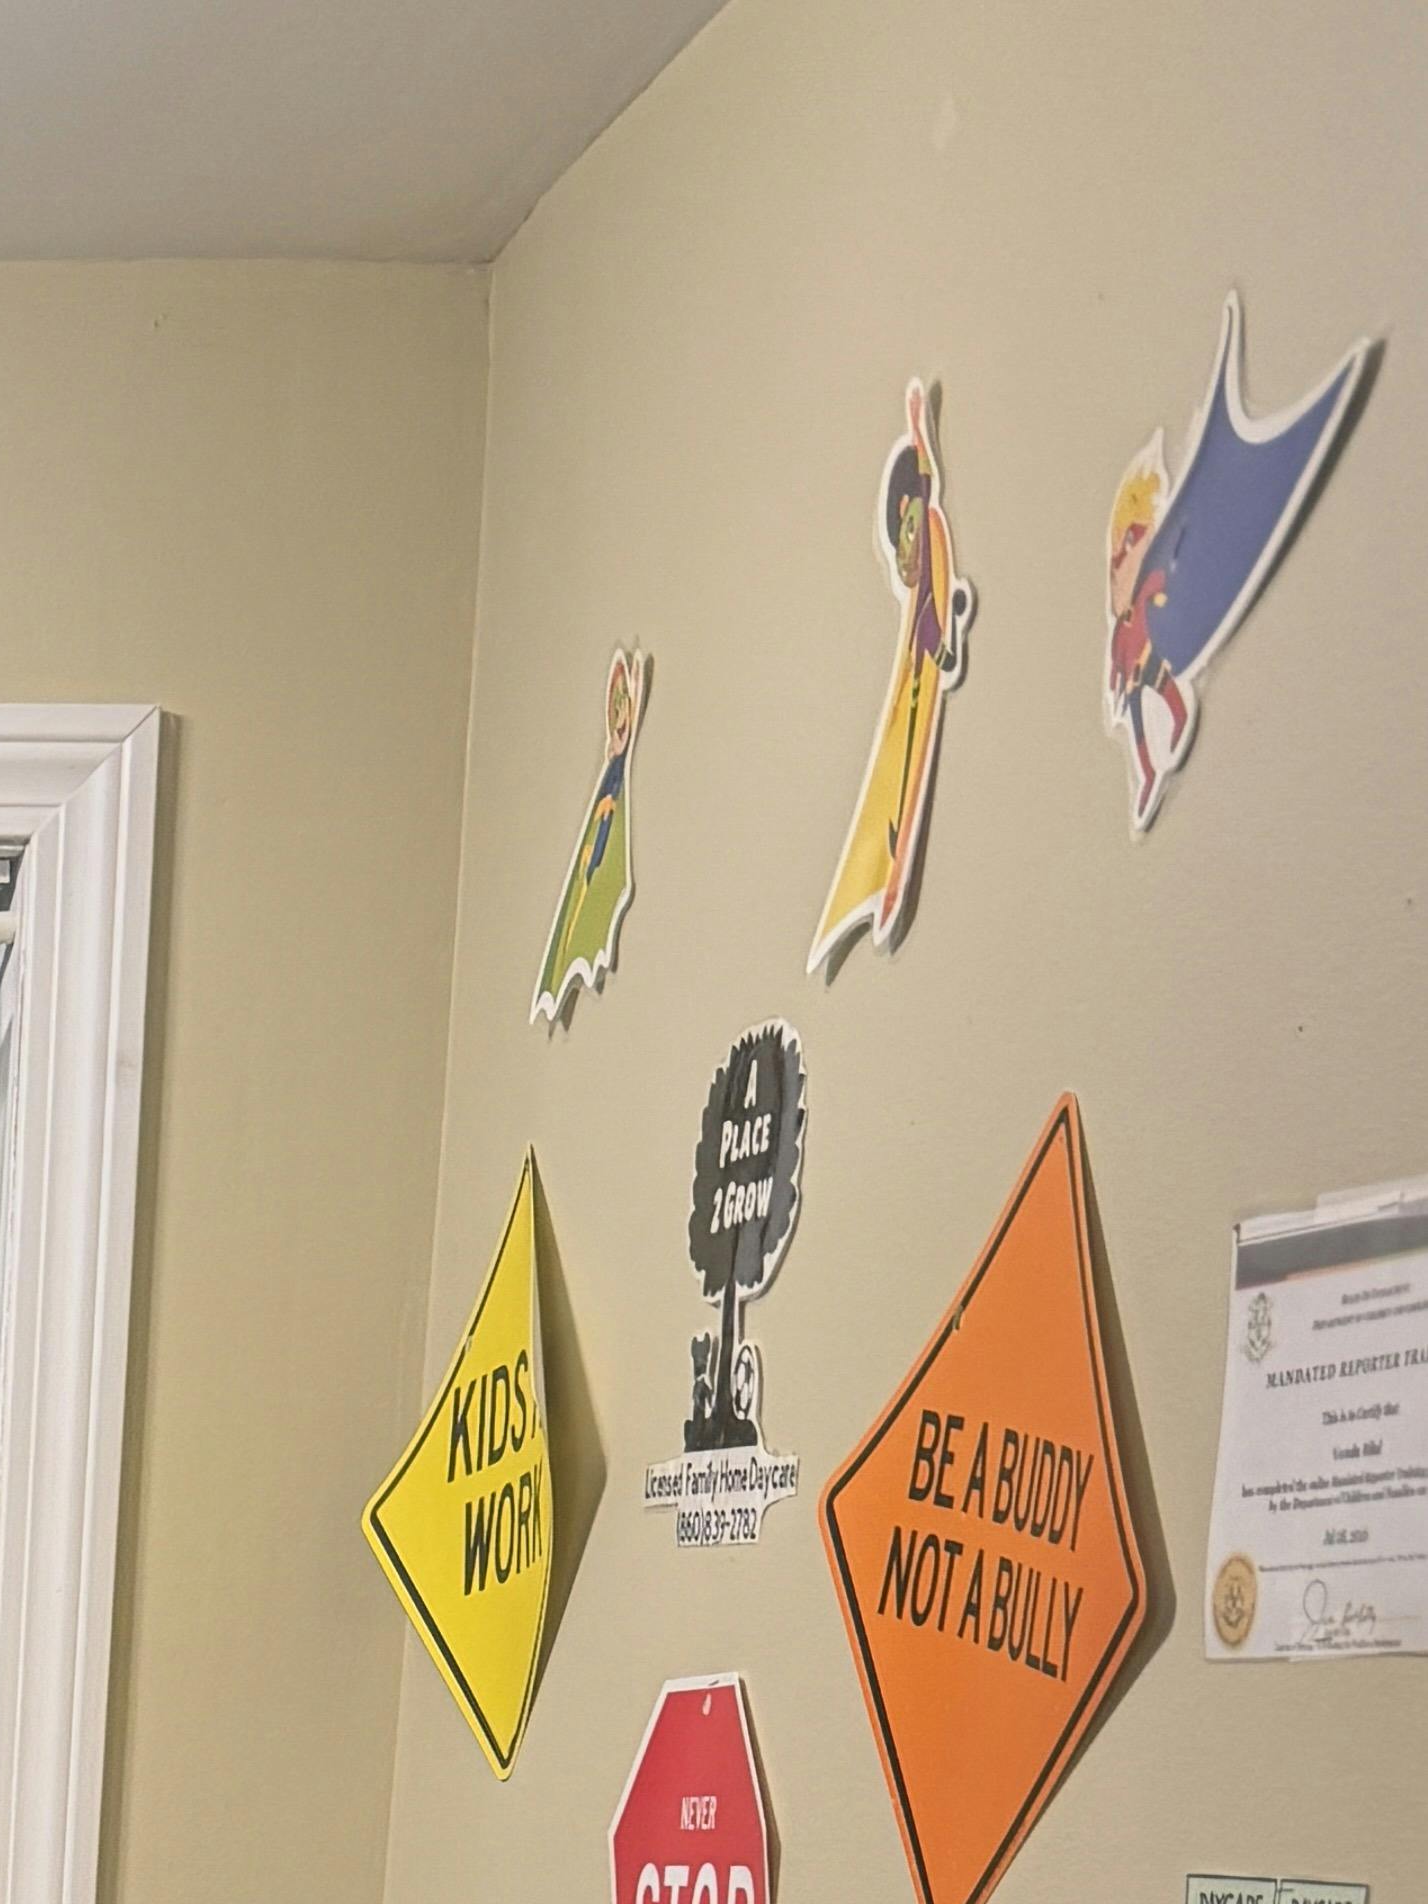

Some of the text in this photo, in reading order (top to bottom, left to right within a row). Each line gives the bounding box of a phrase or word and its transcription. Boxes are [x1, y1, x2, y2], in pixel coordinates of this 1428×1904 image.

[744, 1059, 758, 1109] A
[719, 1113, 772, 1168] PLACE
[447, 1349, 528, 1483] KIDS
[464, 1455, 542, 1596] WORK
[645, 1463, 683, 1499] Licensed
[685, 1460, 719, 1501] Family
[719, 1458, 747, 1493] Home
[908, 1409, 1094, 1552] BE A BUDDY
[878, 1526, 1083, 1682] NOT A BULLY
[680, 1796, 717, 1830] NEVER
